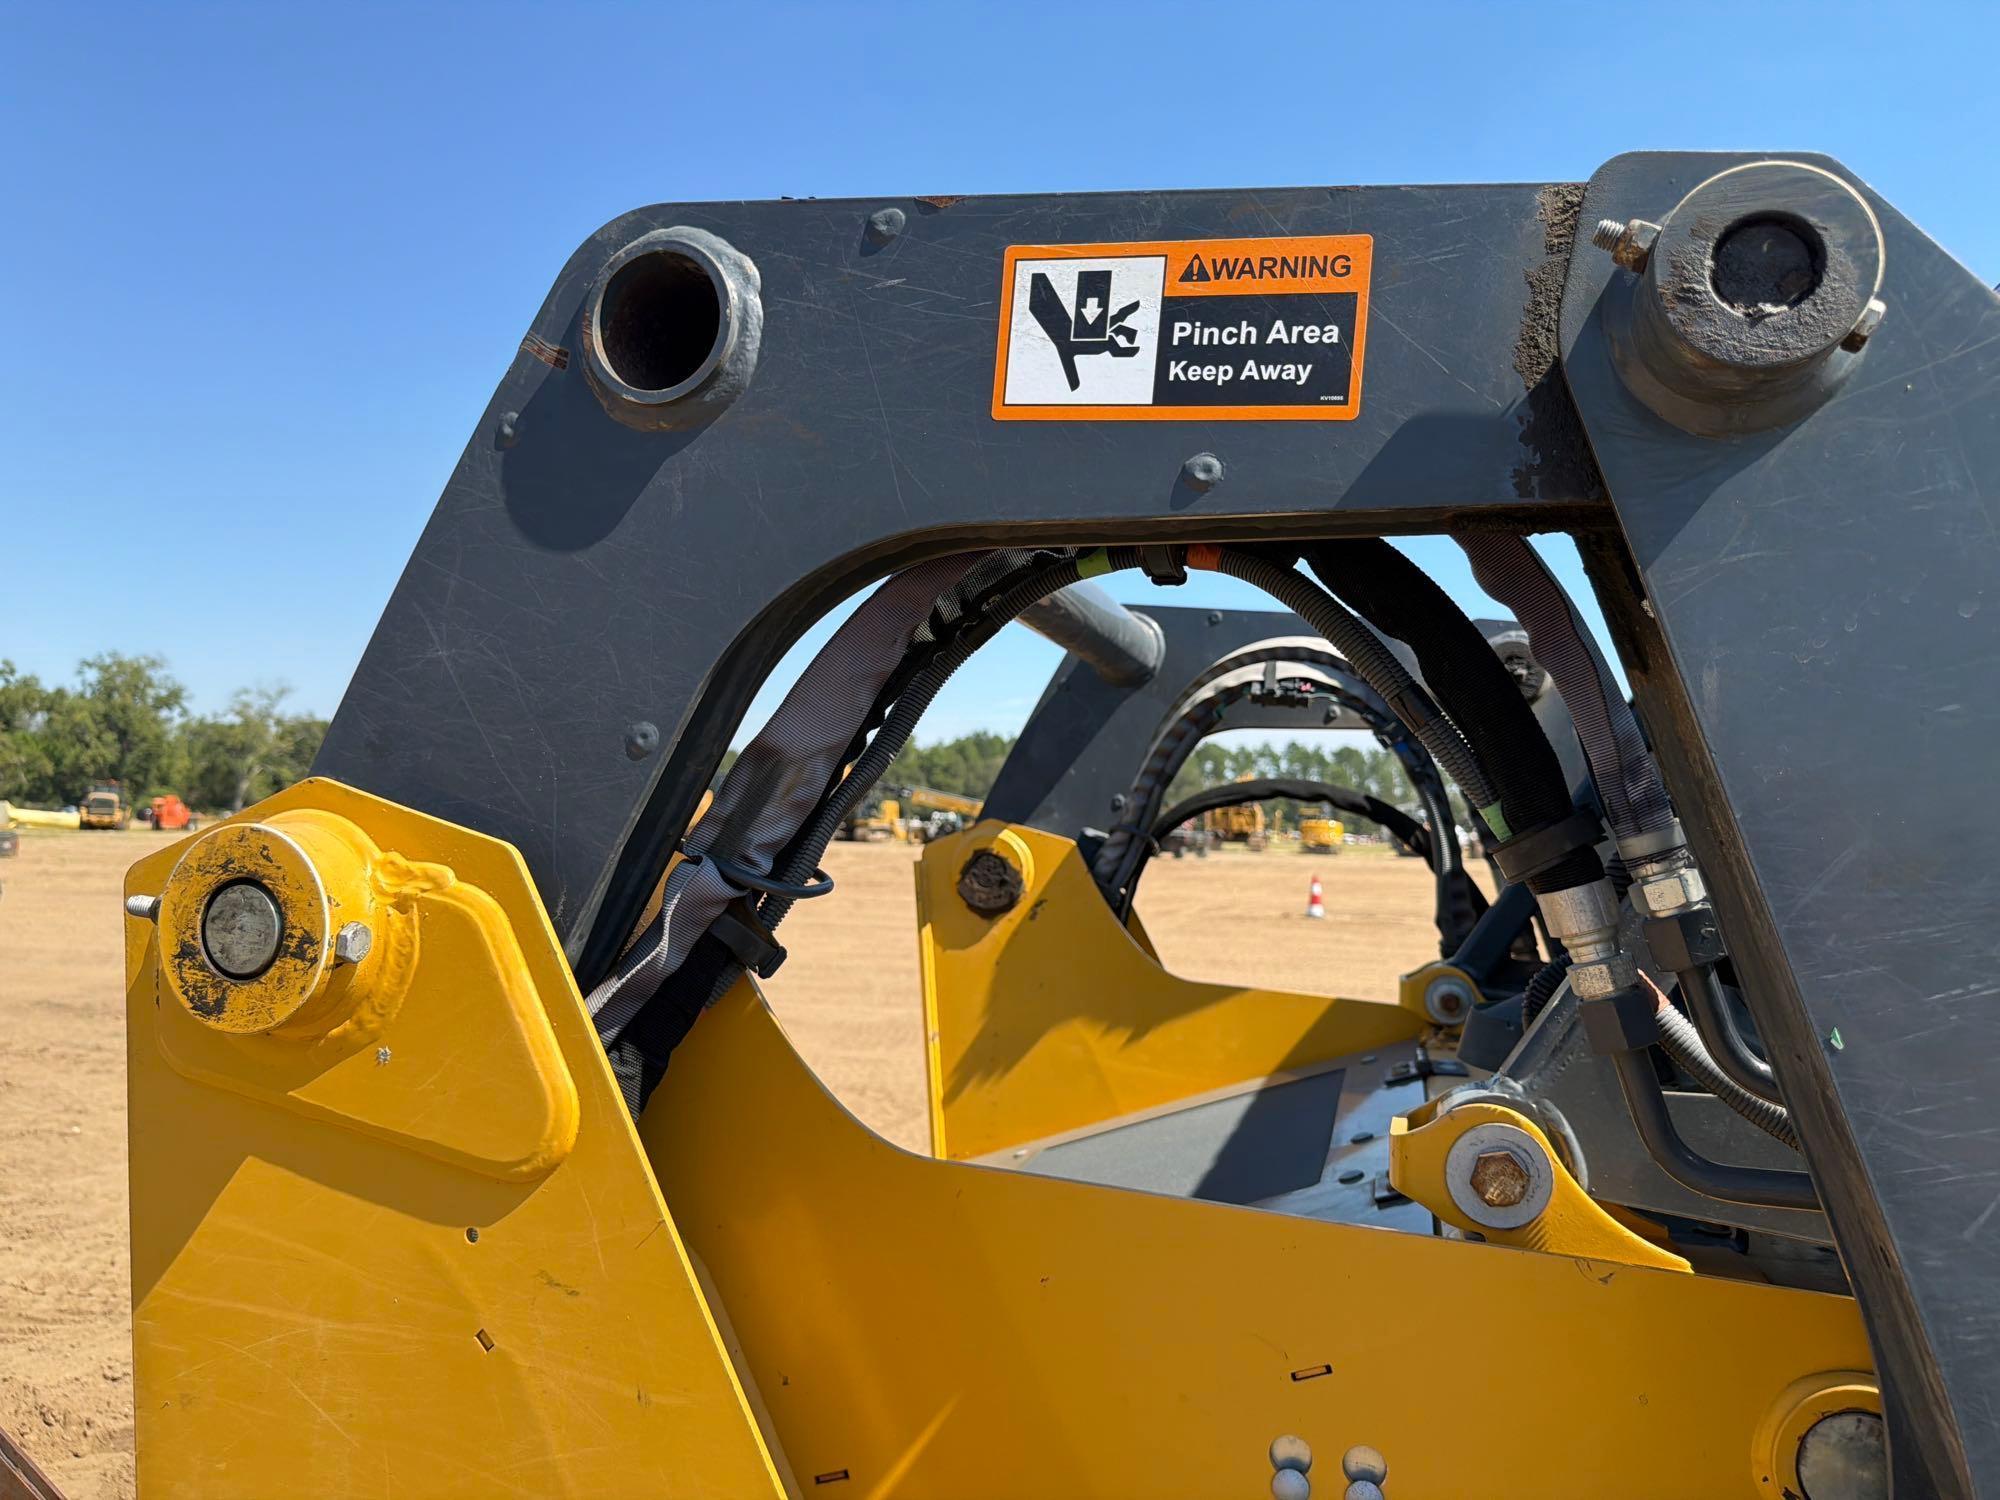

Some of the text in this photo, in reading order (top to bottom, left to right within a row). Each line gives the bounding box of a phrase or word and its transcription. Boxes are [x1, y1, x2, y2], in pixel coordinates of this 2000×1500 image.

[1211, 254, 1352, 281] WARNING
[1172, 319, 1339, 346] Pinch Area
[1168, 359, 1313, 386] Keep Away
